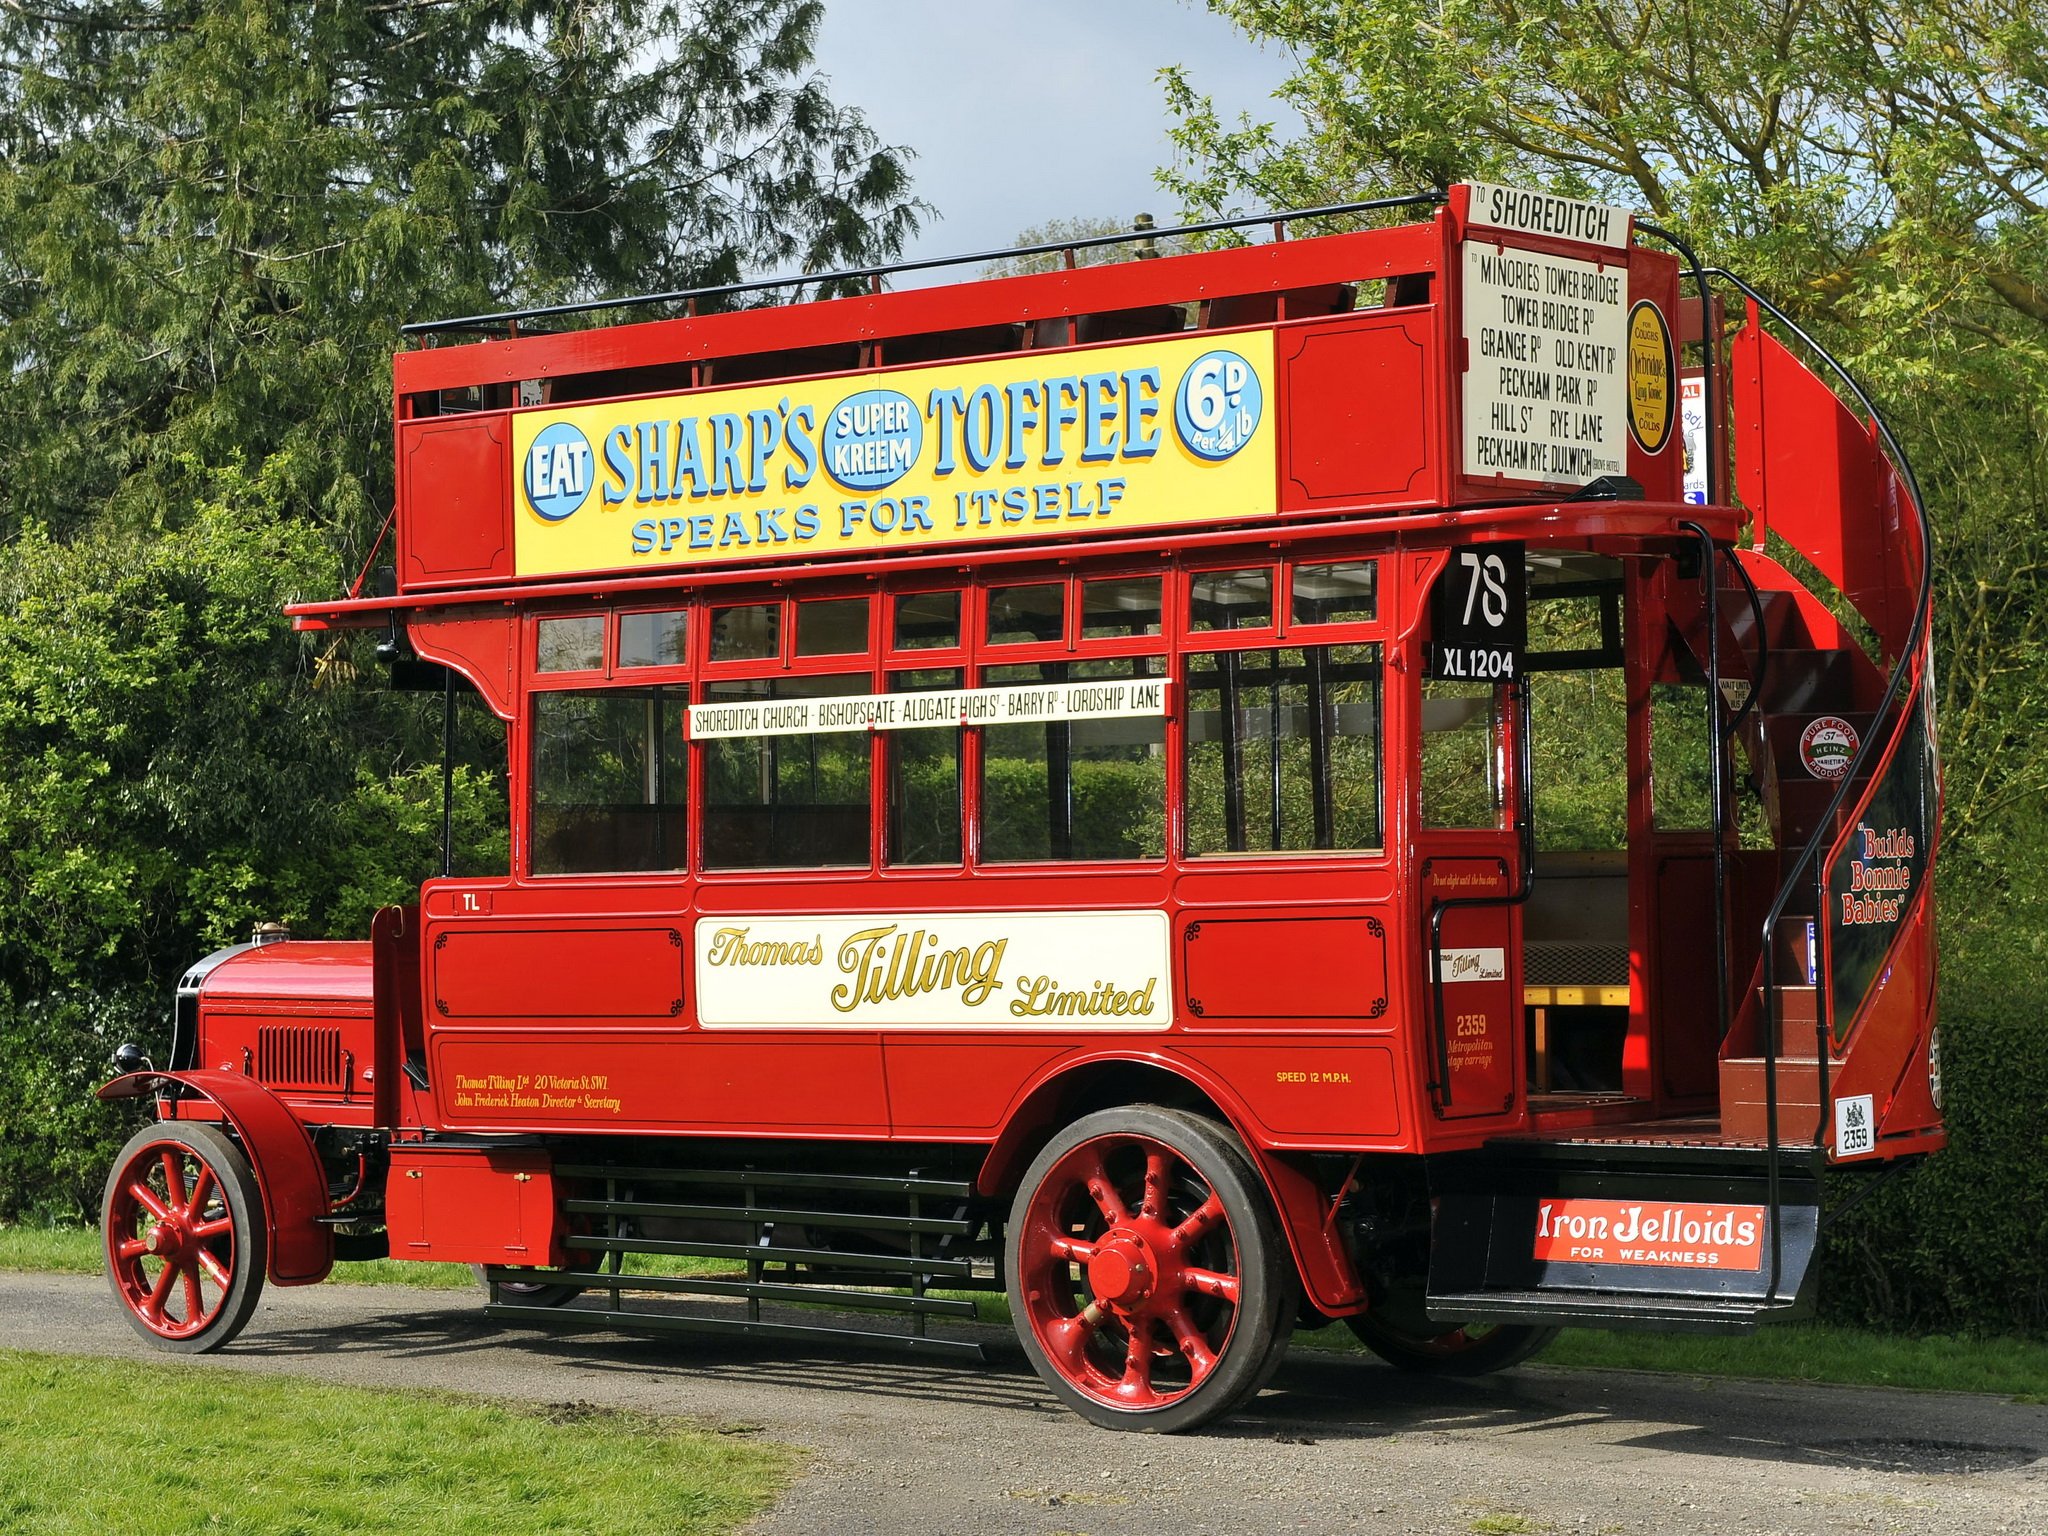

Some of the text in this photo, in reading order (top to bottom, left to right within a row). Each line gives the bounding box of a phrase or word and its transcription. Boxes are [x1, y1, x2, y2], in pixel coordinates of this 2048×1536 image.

[1476, 186, 1610, 242] TO SHOREDITCH
[1480, 254, 1540, 293] MINORIES
[1544, 266, 1580, 298] TOWER
[1582, 272, 1619, 306] BRIDGE
[1501, 294, 1539, 328] TOWER
[1542, 302, 1580, 334] BRIDGE
[1480, 327, 1527, 362] GRANGE
[1555, 339, 1575, 368] OLD
[1577, 343, 1606, 373] KENT
[1634, 326, 1659, 342] COUGHS
[1500, 366, 1550, 401] PECKHAM
[1556, 375, 1582, 405] PARK
[836, 400, 910, 438] SUPER
[1491, 402, 1517, 433] HILL
[1550, 409, 1569, 439] RYE
[1574, 413, 1603, 443] LANE
[1638, 418, 1660, 432] COLDS
[603, 365, 1162, 508] SHARP'S TOFFEE
[530, 440, 588, 499] EAT
[834, 436, 912, 478] KREEM
[1477, 436, 1527, 470] PECKHAM
[1530, 443, 1548, 473] RYE
[1551, 445, 1592, 478] DULWICH
[632, 477, 1126, 554] SPEAKS FOR ITSELF
[1460, 552, 1508, 628] 78
[1442, 647, 1514, 678] XL 1204
[695, 708, 758, 732] SHOREDITCH
[763, 704, 808, 729] CHURCH
[818, 700, 896, 726] BISHOPSGATE
[902, 696, 956, 722] ALDGATE
[960, 694, 987, 720] HIGH
[1008, 692, 1043, 716] BARRY
[1067, 686, 1125, 712] LORDSHIP
[1130, 684, 1160, 710] LANE
[1735, 690, 1746, 699] THE
[1806, 720, 1854, 742] PURE FOOD
[1824, 732, 1836, 740] 57
[1816, 746, 1846, 754] HEINZ
[1850, 859, 1910, 892] Bonnie
[462, 893, 480, 910] TL
[708, 923, 1158, 1017] Thomas Tilling Limited
[1452, 953, 1480, 978] Tilling
[1479, 968, 1503, 979] Limited
[1456, 1014, 1486, 1036] 2359
[1276, 1072, 1352, 1083] SPEED 12 M.P.H.
[1464, 1054, 1492, 1070] carriage
[456, 1074, 487, 1090] Thomas
[488, 1075, 515, 1092] Tilling
[534, 1074, 548, 1090] 20
[549, 1076, 580, 1090] Victoria
[455, 1092, 473, 1107] John
[474, 1092, 509, 1108] Frederick
[510, 1093, 540, 1108] Heaton
[542, 1094, 576, 1108] Director
[584, 1094, 621, 1114] Secretary
[1844, 1128, 1868, 1150] 2359
[1538, 1203, 1608, 1240] Iron
[1570, 1246, 1720, 1264] FOR WEAKNESS
